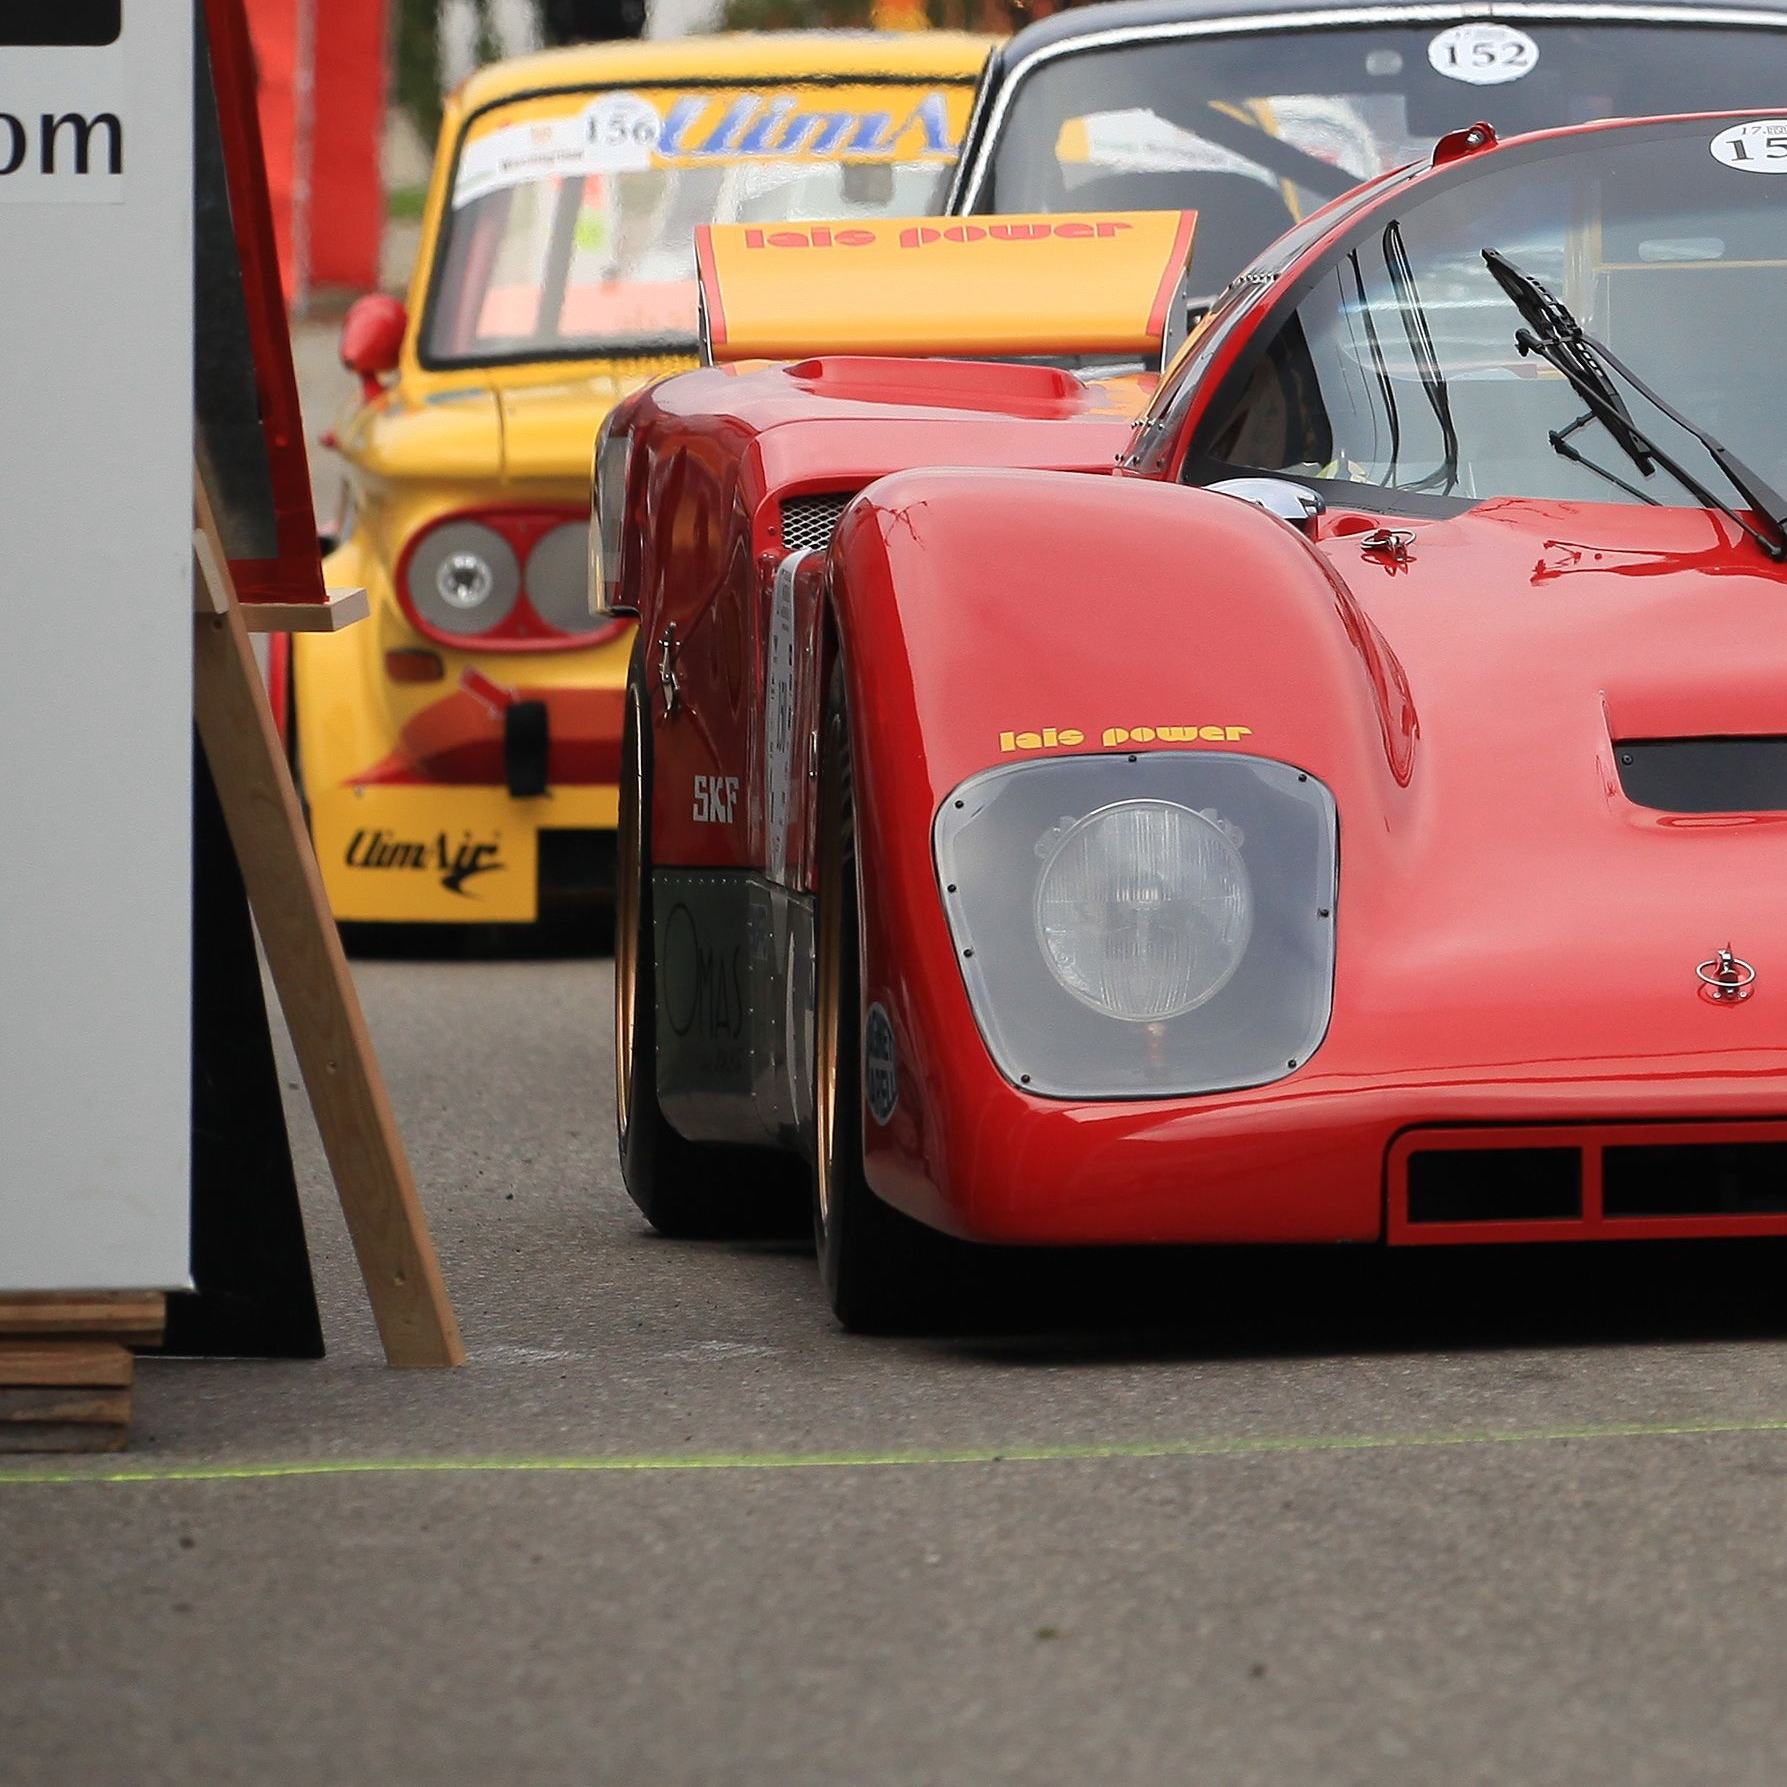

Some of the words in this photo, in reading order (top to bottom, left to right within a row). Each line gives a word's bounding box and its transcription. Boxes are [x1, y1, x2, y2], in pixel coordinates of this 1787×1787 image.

[1444, 42, 1528, 67] 152
[584, 114, 657, 146] 156
[898, 221, 1134, 249] power
[1102, 725, 1252, 747] power
[693, 775, 740, 824] SKF
